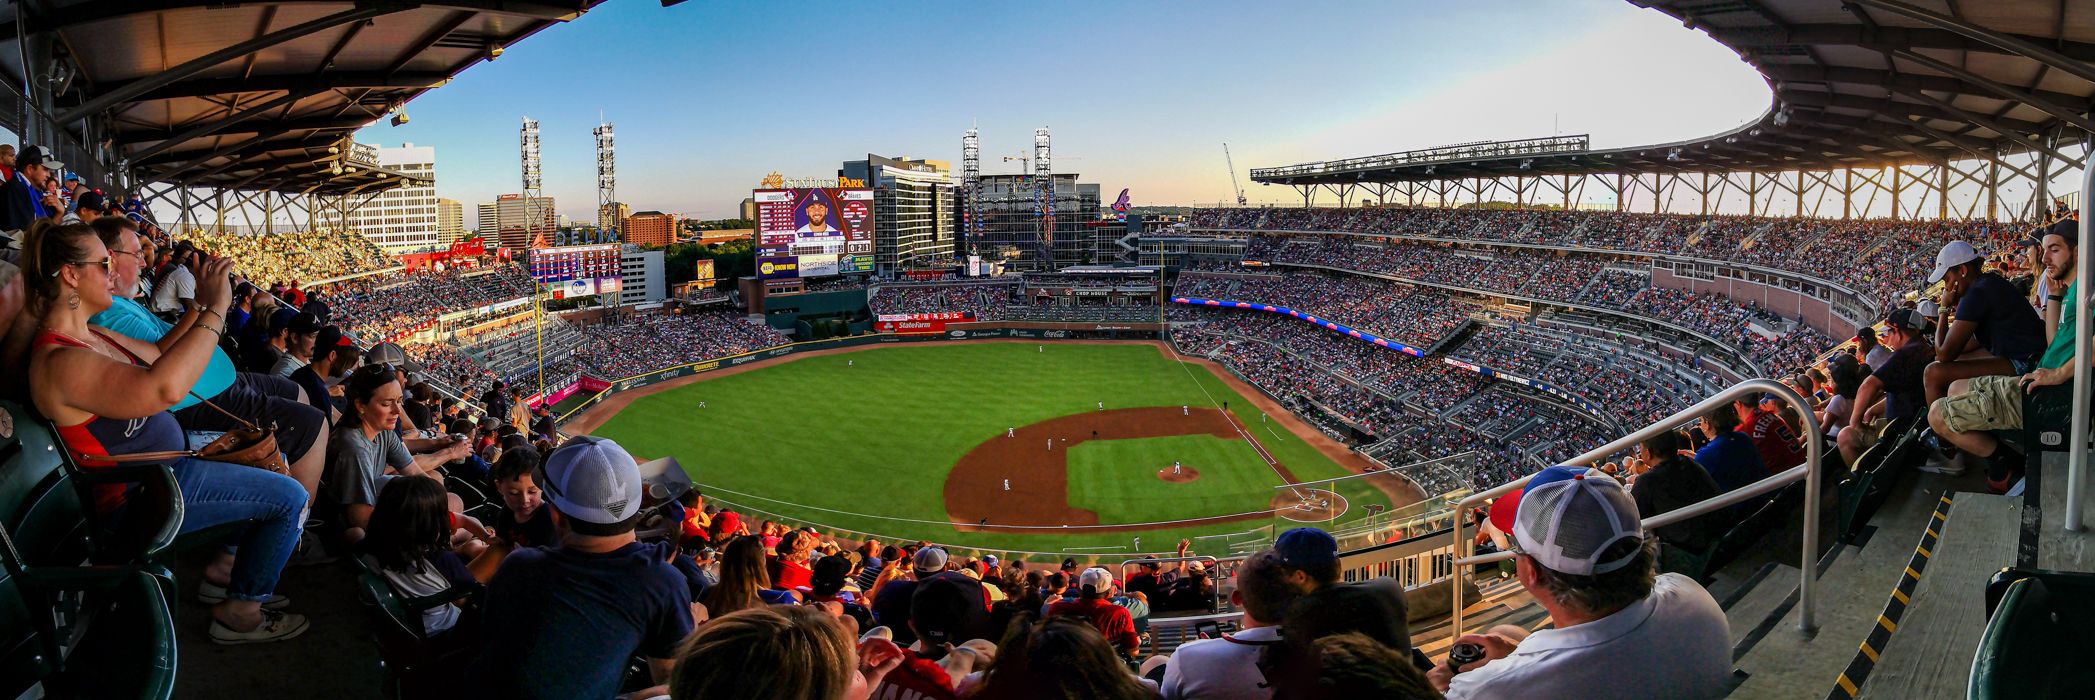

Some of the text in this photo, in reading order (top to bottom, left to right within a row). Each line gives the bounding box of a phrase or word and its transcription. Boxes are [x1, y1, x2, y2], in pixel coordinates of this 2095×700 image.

[555, 229, 618, 246] DELTA
[732, 354, 756, 365] EQUIFAX
[660, 368, 680, 381] xfinity
[1774, 423, 1801, 453] 5
[2046, 434, 2057, 443] 10
